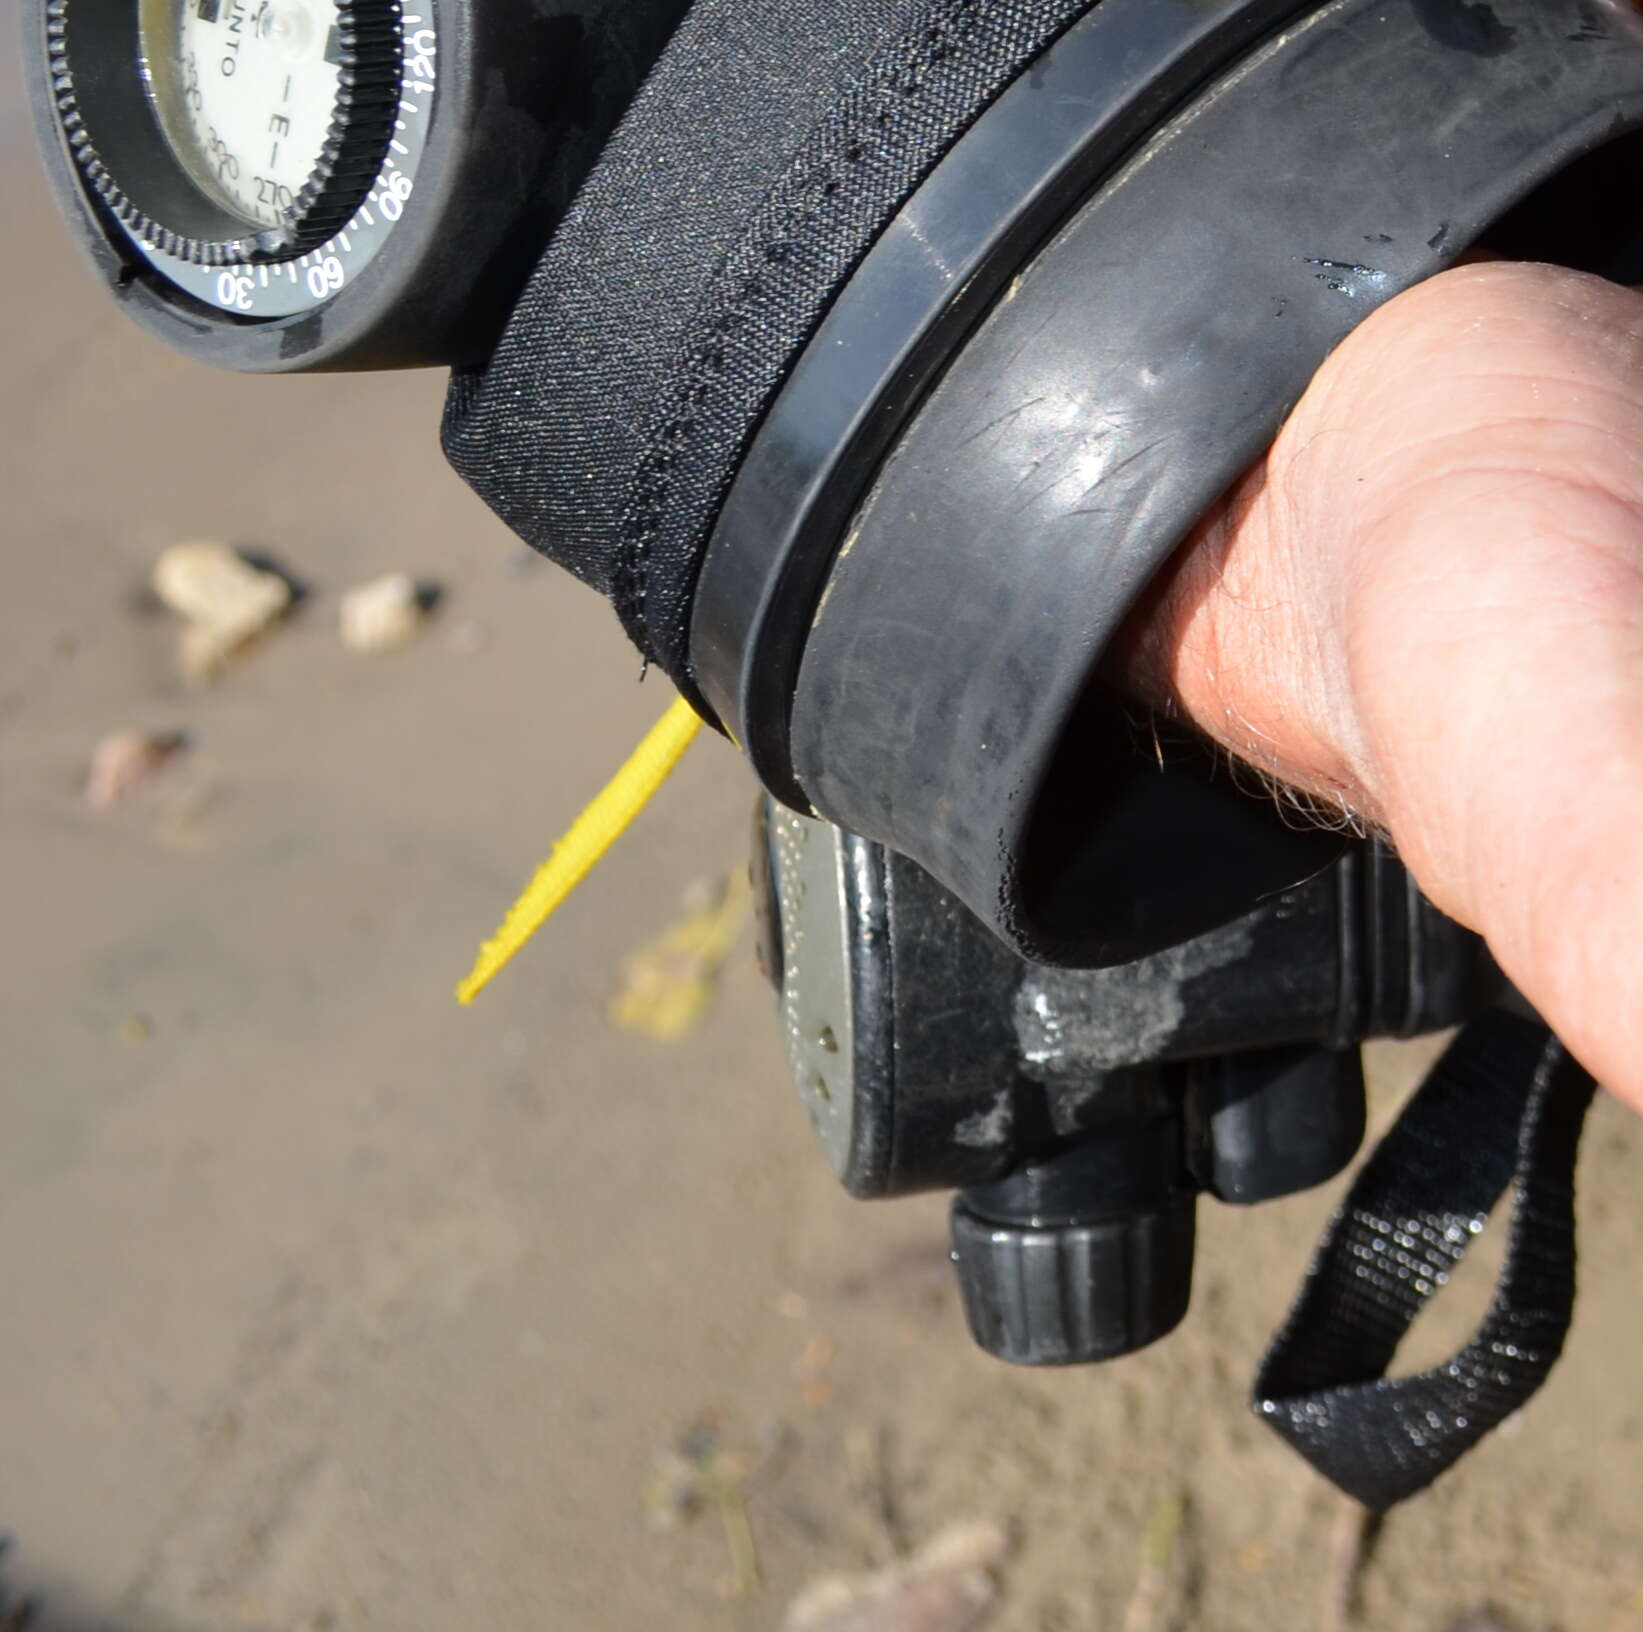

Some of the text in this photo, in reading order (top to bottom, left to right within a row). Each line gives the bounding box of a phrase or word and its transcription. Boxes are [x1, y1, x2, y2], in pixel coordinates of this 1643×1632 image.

[269, 113, 290, 137] E
[254, 176, 293, 209] 270
[378, 171, 414, 221] 90
[217, 272, 256, 309] 30
[308, 257, 344, 298] 60
